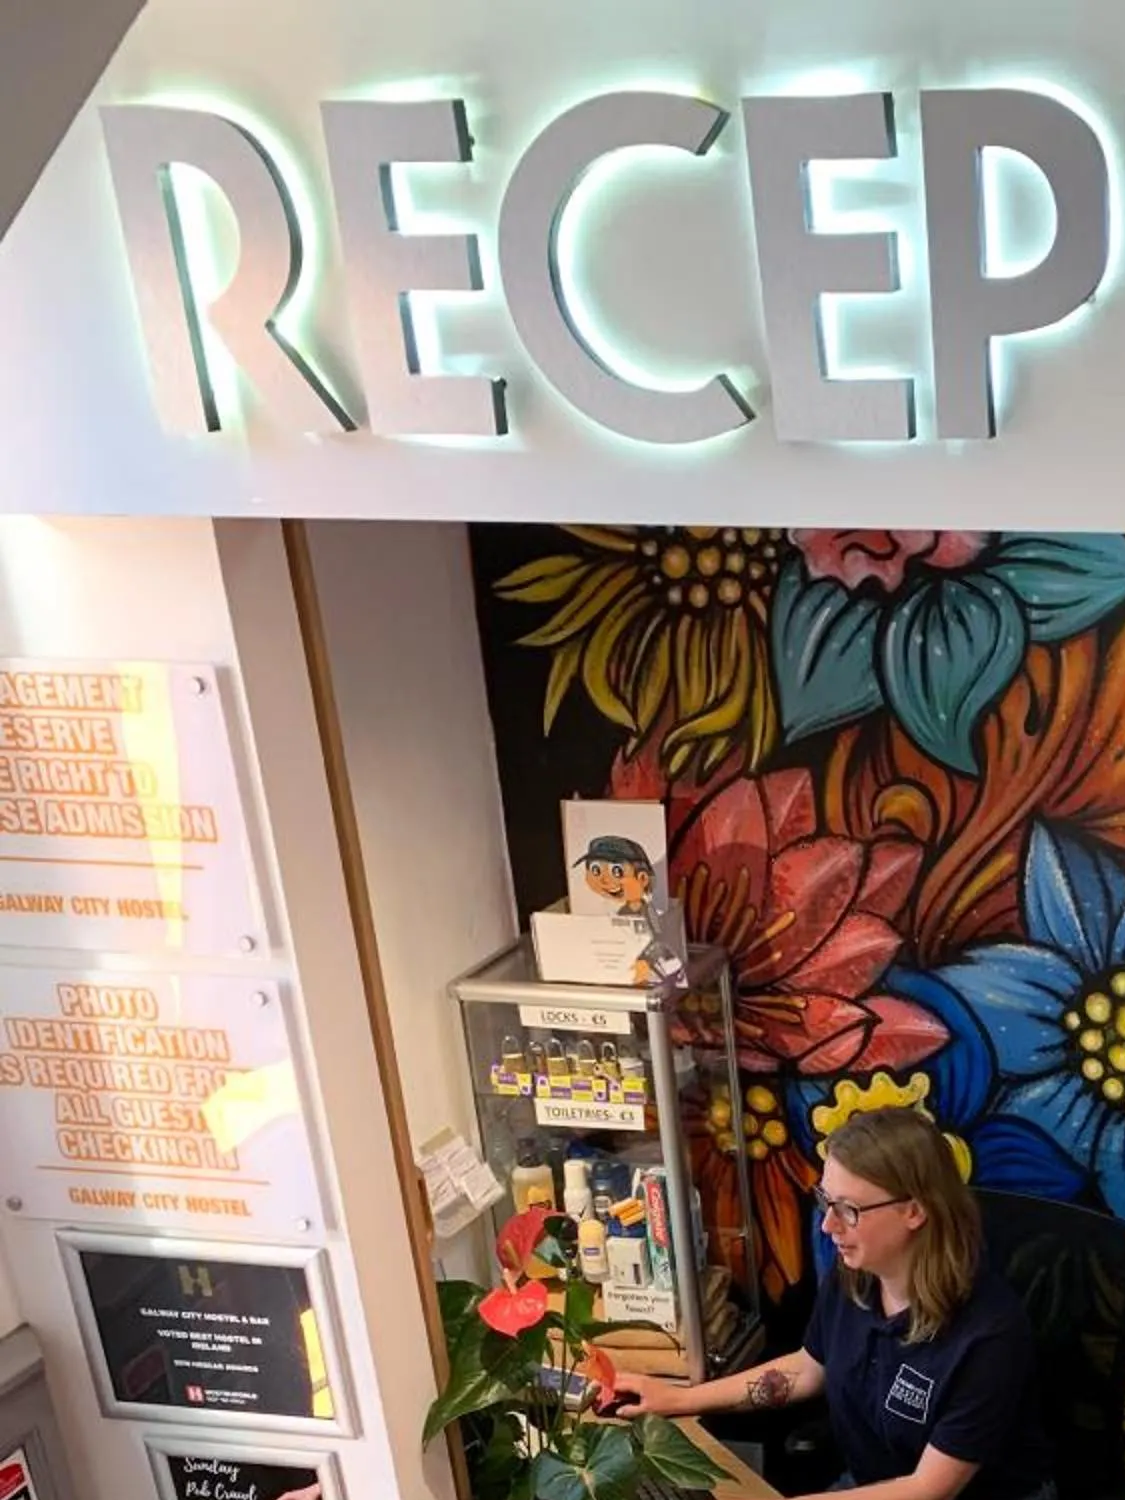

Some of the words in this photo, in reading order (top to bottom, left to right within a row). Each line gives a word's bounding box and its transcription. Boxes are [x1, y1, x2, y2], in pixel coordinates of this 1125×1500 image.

[16, 757, 109, 797] RIGHT
[108, 761, 158, 798] TO
[45, 800, 218, 843] ADMISSION
[71, 895, 111, 916] CITY
[57, 983, 159, 1021] PHOTO
[541, 1011, 579, 1023] LOCKS
[4, 1018, 231, 1062] IDENTIFICATION
[25, 1055, 172, 1094] REQUIRED
[56, 1093, 111, 1127] ALL
[112, 1096, 226, 1135] GUEST
[57, 1127, 201, 1168] CHECKING
[69, 1187, 136, 1208] GALWAY
[142, 1193, 180, 1211] CITY
[186, 1197, 253, 1217] HOSTEL
[181, 1311, 203, 1320] CITY
[203, 1312, 241, 1323] HOSTEL
[183, 1456, 241, 1483] Sunday
